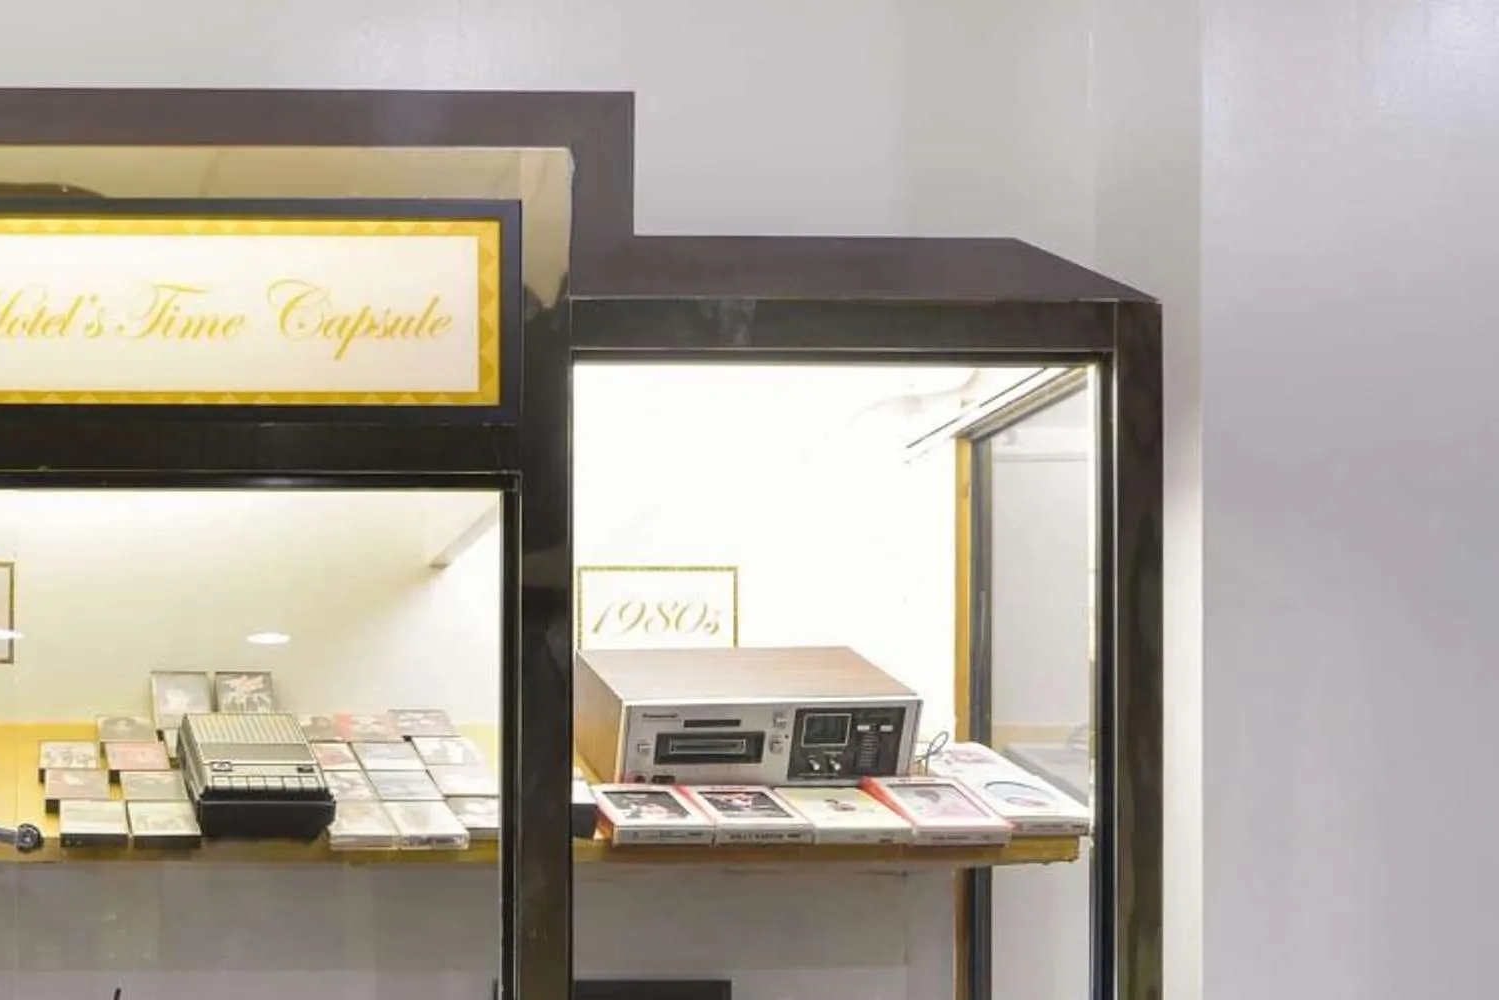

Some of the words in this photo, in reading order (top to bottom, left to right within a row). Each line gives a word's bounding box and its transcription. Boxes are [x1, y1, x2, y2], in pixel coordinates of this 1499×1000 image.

[115, 282, 247, 338] Time
[266, 279, 454, 360] Capsule
[591, 599, 721, 637] 1980s
